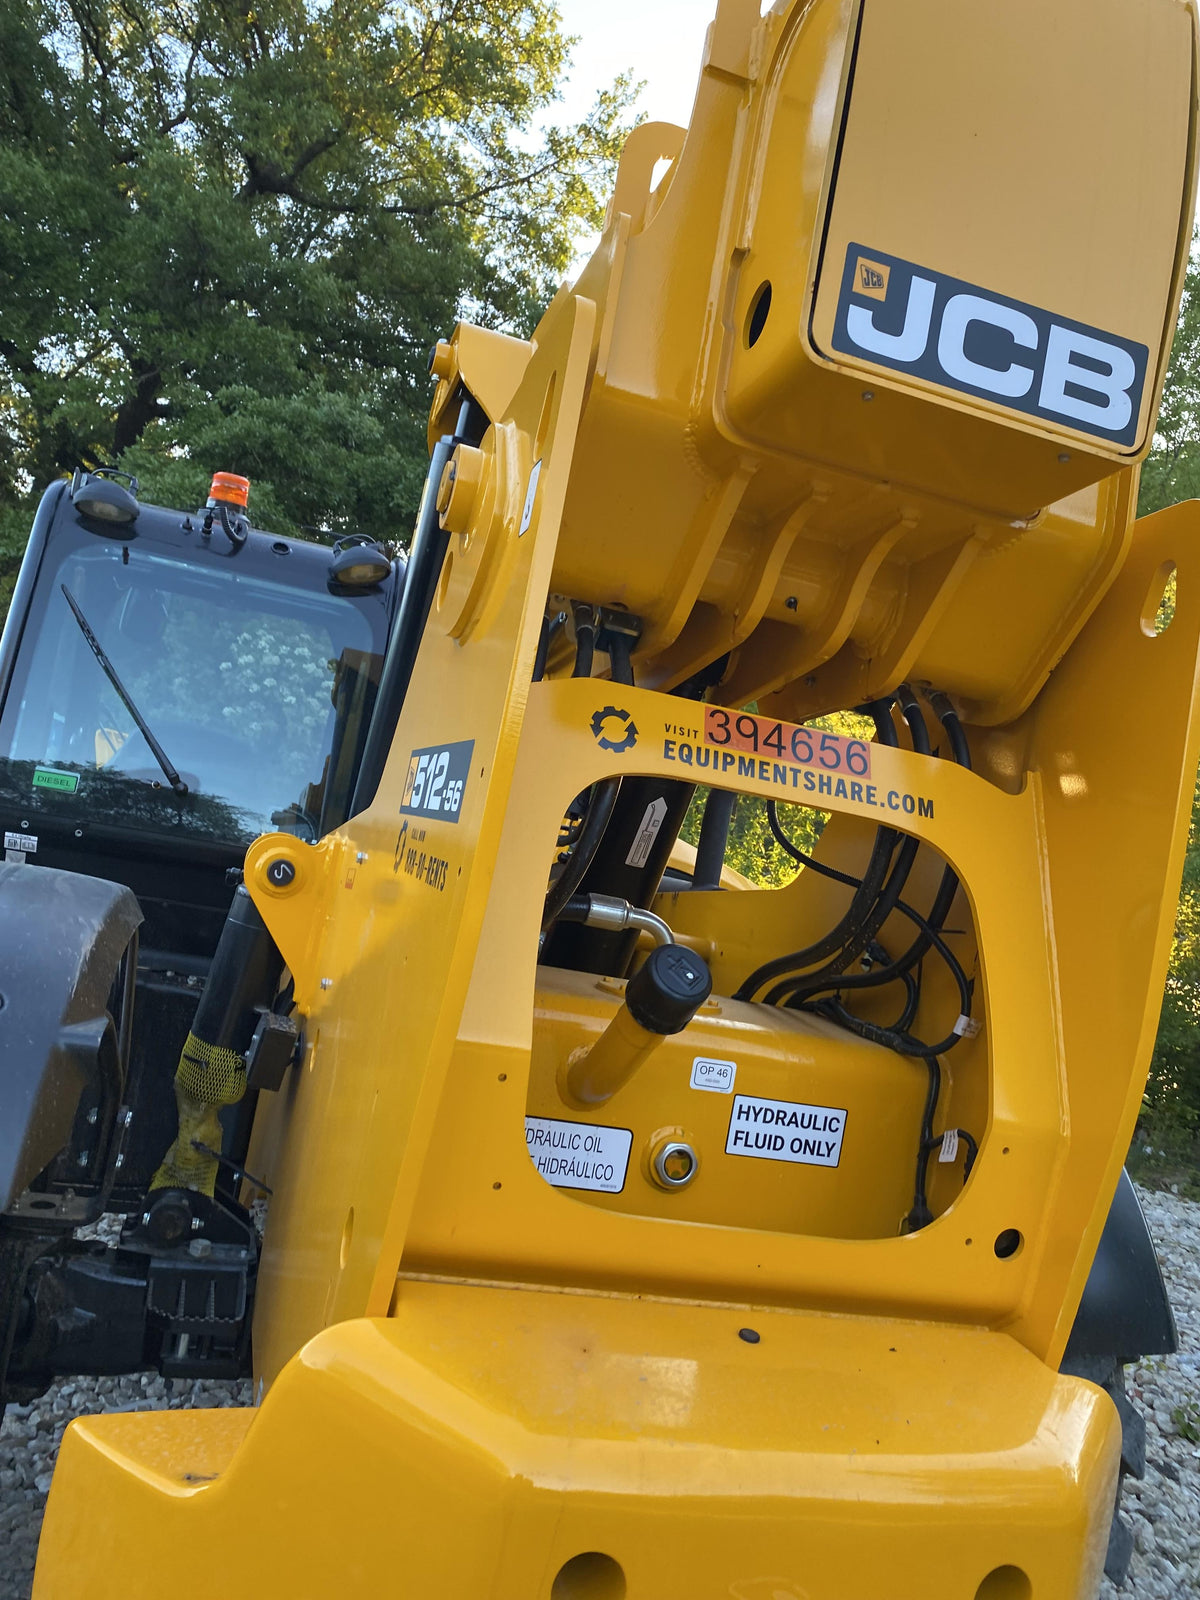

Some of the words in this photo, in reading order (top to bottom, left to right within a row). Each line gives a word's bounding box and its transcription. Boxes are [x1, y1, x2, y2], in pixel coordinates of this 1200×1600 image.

[863, 267, 883, 287] JCB
[846, 274, 1136, 431] JCB
[664, 723, 699, 739] VISIT
[708, 709, 869, 776] 394656
[37, 775, 71, 787] DIESEL
[663, 739, 935, 819] EQUIPMENTSHARE.COM
[700, 1065, 715, 1075] OP
[716, 1068, 729, 1078] 46
[737, 1104, 840, 1133] HYDRAULIC
[525, 1127, 581, 1150] DRAULIC
[584, 1135, 603, 1153] OIL
[733, 1130, 785, 1152] FLUID
[790, 1137, 836, 1158] ONLY
[537, 1156, 614, 1181] HIDRÁULICO
